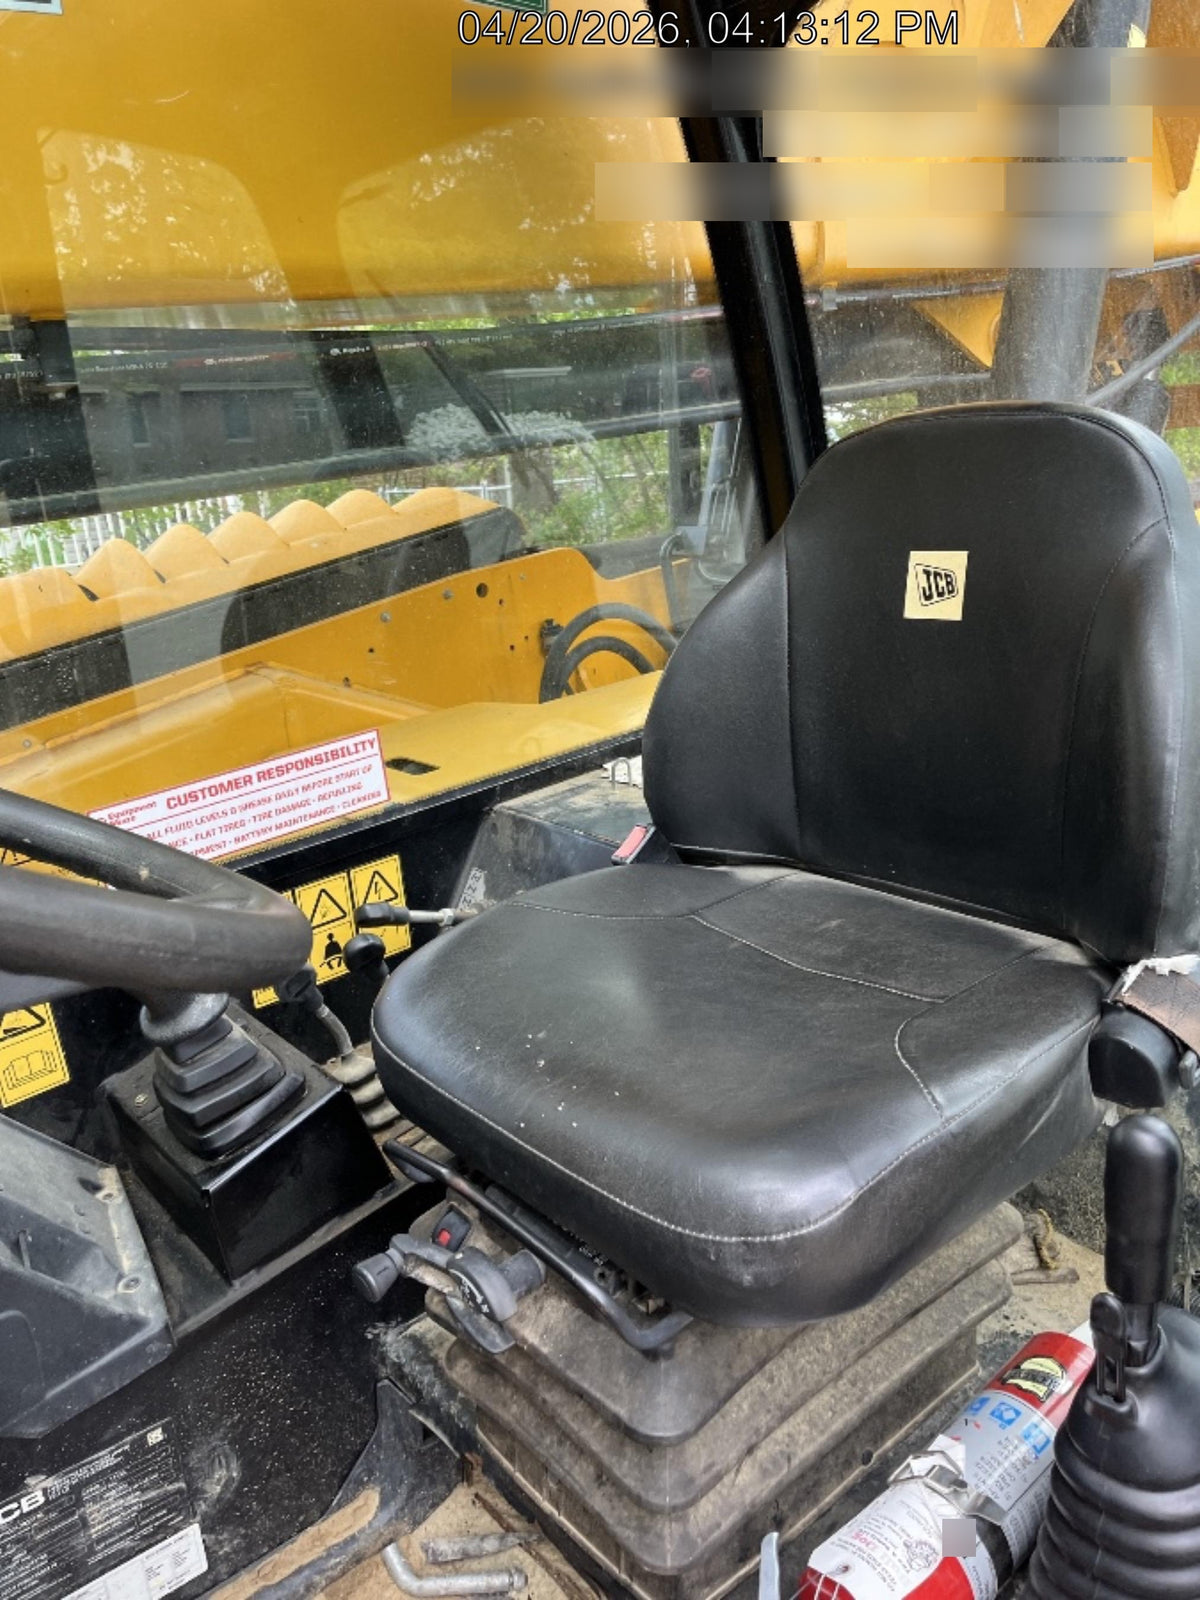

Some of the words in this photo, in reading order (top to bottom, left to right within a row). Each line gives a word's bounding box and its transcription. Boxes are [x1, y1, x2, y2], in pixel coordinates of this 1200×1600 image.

[920, 568, 957, 602] JCB
[166, 773, 254, 810] CUSTOMER
[256, 737, 376, 784] RESPONSIBILITY
[164, 820, 194, 836] FLUID
[195, 809, 228, 826] LEVELS
[335, 767, 360, 783] START
[194, 828, 217, 840] FLAT
[252, 809, 273, 823] TIRE
[274, 799, 312, 815] DAMAGE
[274, 805, 336, 831] MAINTENANCE
[0, 1489, 46, 1525] CB
